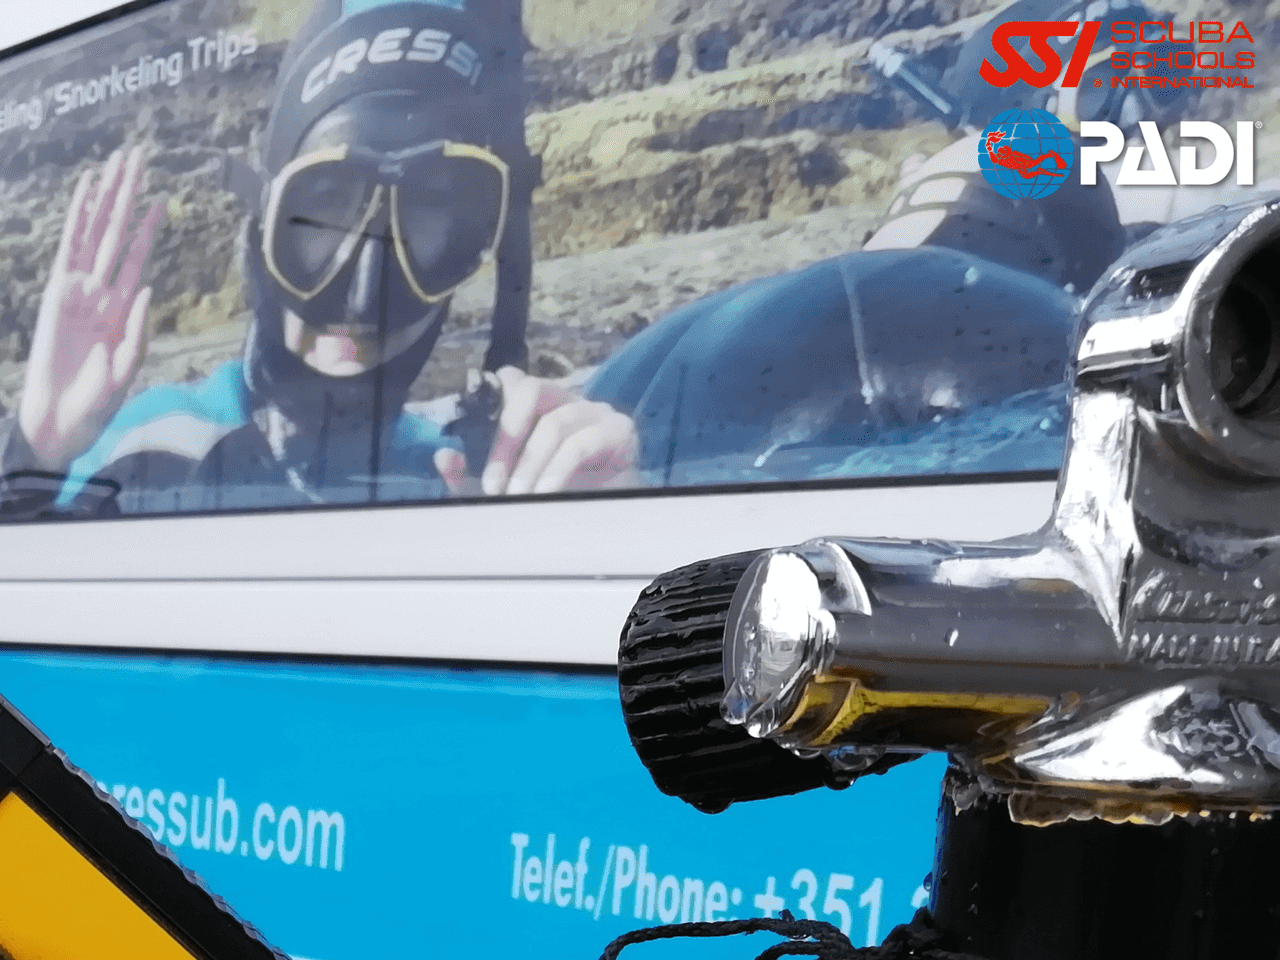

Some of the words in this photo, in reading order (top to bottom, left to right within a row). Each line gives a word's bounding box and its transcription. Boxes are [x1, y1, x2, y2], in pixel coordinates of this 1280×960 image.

[53, 51, 183, 115] Snorkeling
[187, 27, 259, 73] Trips
[301, 27, 483, 104] CRESSI
